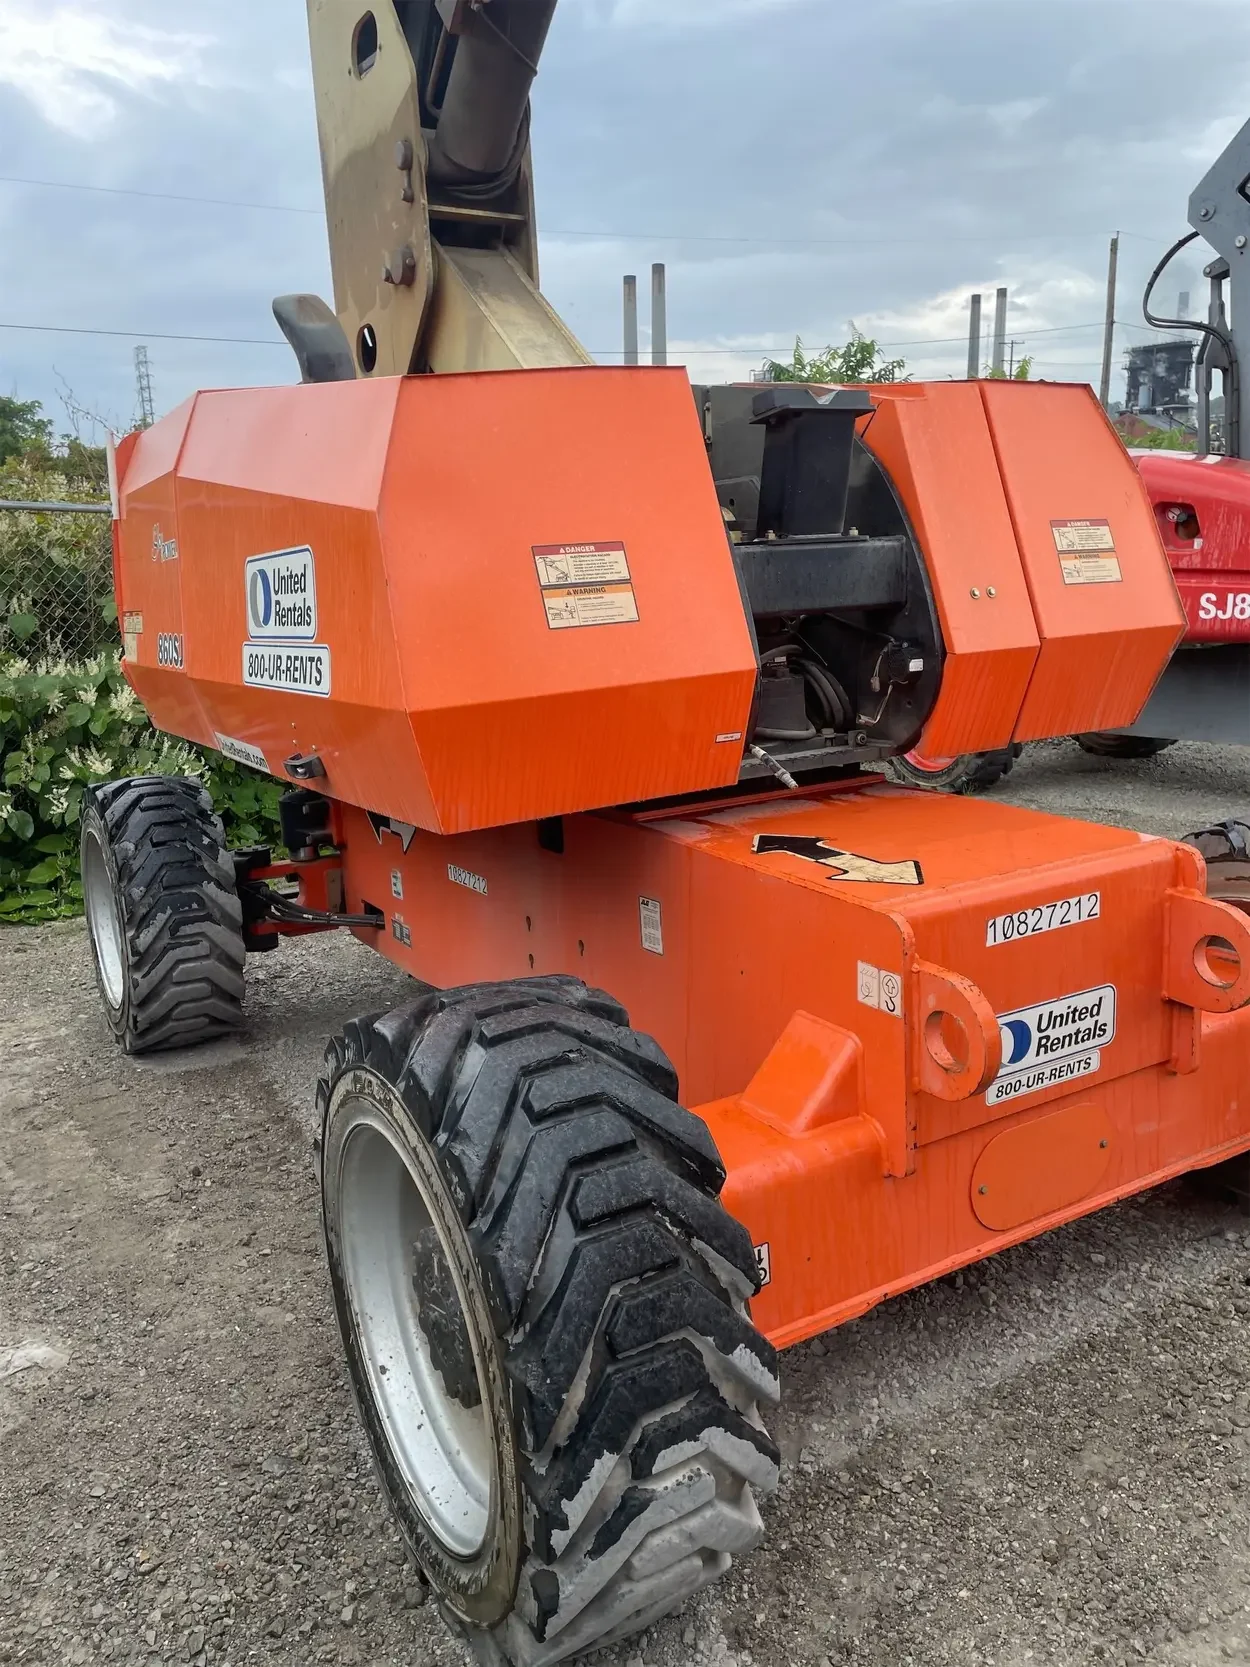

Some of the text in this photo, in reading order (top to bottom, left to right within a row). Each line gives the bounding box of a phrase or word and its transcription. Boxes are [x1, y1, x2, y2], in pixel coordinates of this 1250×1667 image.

[565, 545, 596, 553] DANGER
[272, 563, 306, 595] United
[572, 586, 607, 595] WARNING
[274, 599, 312, 628] Rentals
[1198, 592, 1250, 620] SJ8
[158, 633, 184, 668] 860SJ
[248, 653, 323, 687] 800-UR-RENTS
[447, 865, 488, 894] 10827212
[989, 893, 1098, 943] 10827212
[1037, 996, 1103, 1034] United
[1035, 1019, 1107, 1058] Rentals
[996, 1056, 1092, 1099] 800-UR-RENTS
